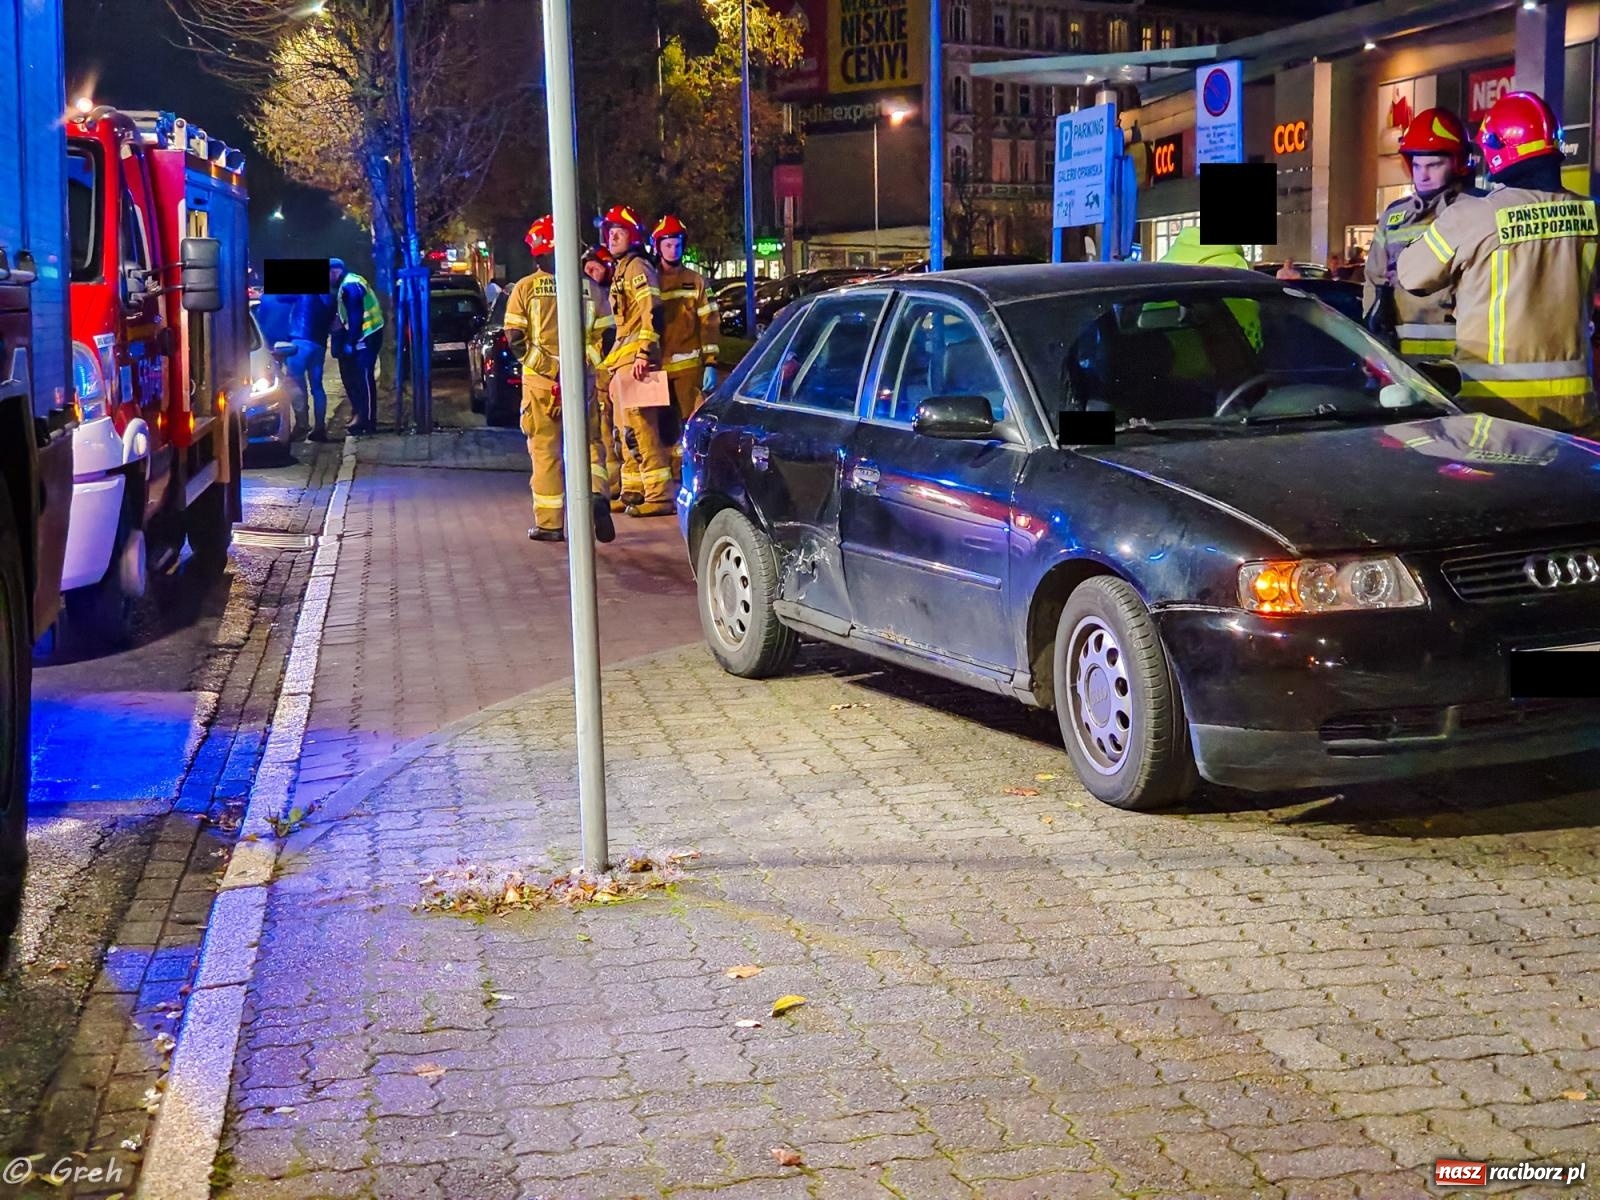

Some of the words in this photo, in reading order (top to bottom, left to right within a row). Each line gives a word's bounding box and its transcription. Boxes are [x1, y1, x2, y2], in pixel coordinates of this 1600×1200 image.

[840, 7, 908, 47] NISKIE
[840, 42, 908, 84] CENY!
[1073, 118, 1104, 139] PARKING
[1273, 120, 1305, 154] CCC
[1155, 144, 1175, 175] CCC
[1507, 203, 1586, 223] PAŃSTWOWA
[1500, 222, 1541, 240] STRAŻ
[1541, 217, 1595, 233] POŻARNA
[535, 286, 557, 296] STRA
